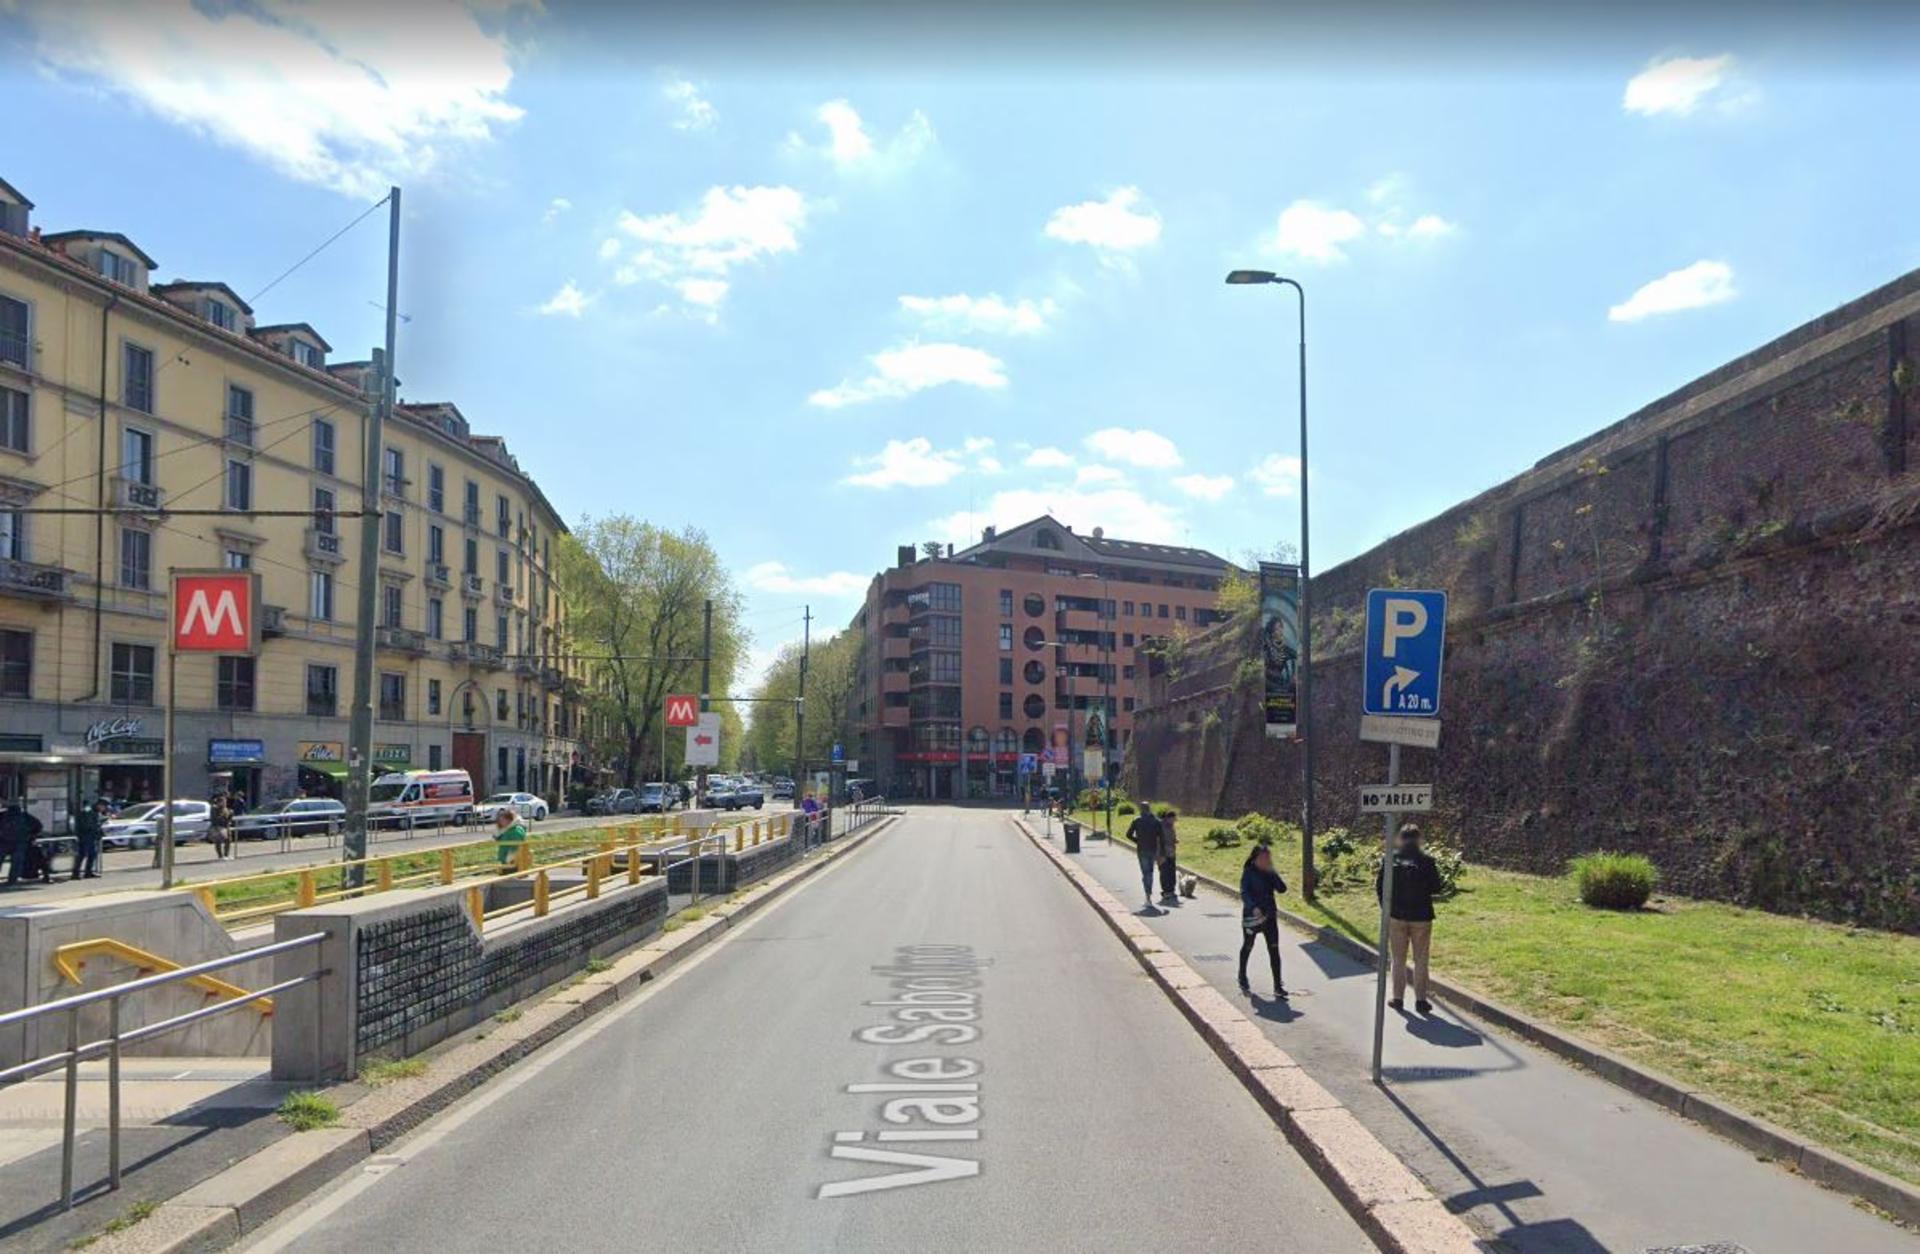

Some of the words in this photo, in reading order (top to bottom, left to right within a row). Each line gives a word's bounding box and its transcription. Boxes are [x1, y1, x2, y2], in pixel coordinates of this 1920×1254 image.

[180, 589, 244, 636] M
[1383, 598, 1428, 658] P
[668, 701, 694, 720] M
[1398, 694, 1406, 709] A
[1407, 694, 1419, 709] 20
[1363, 794, 1380, 806] NO
